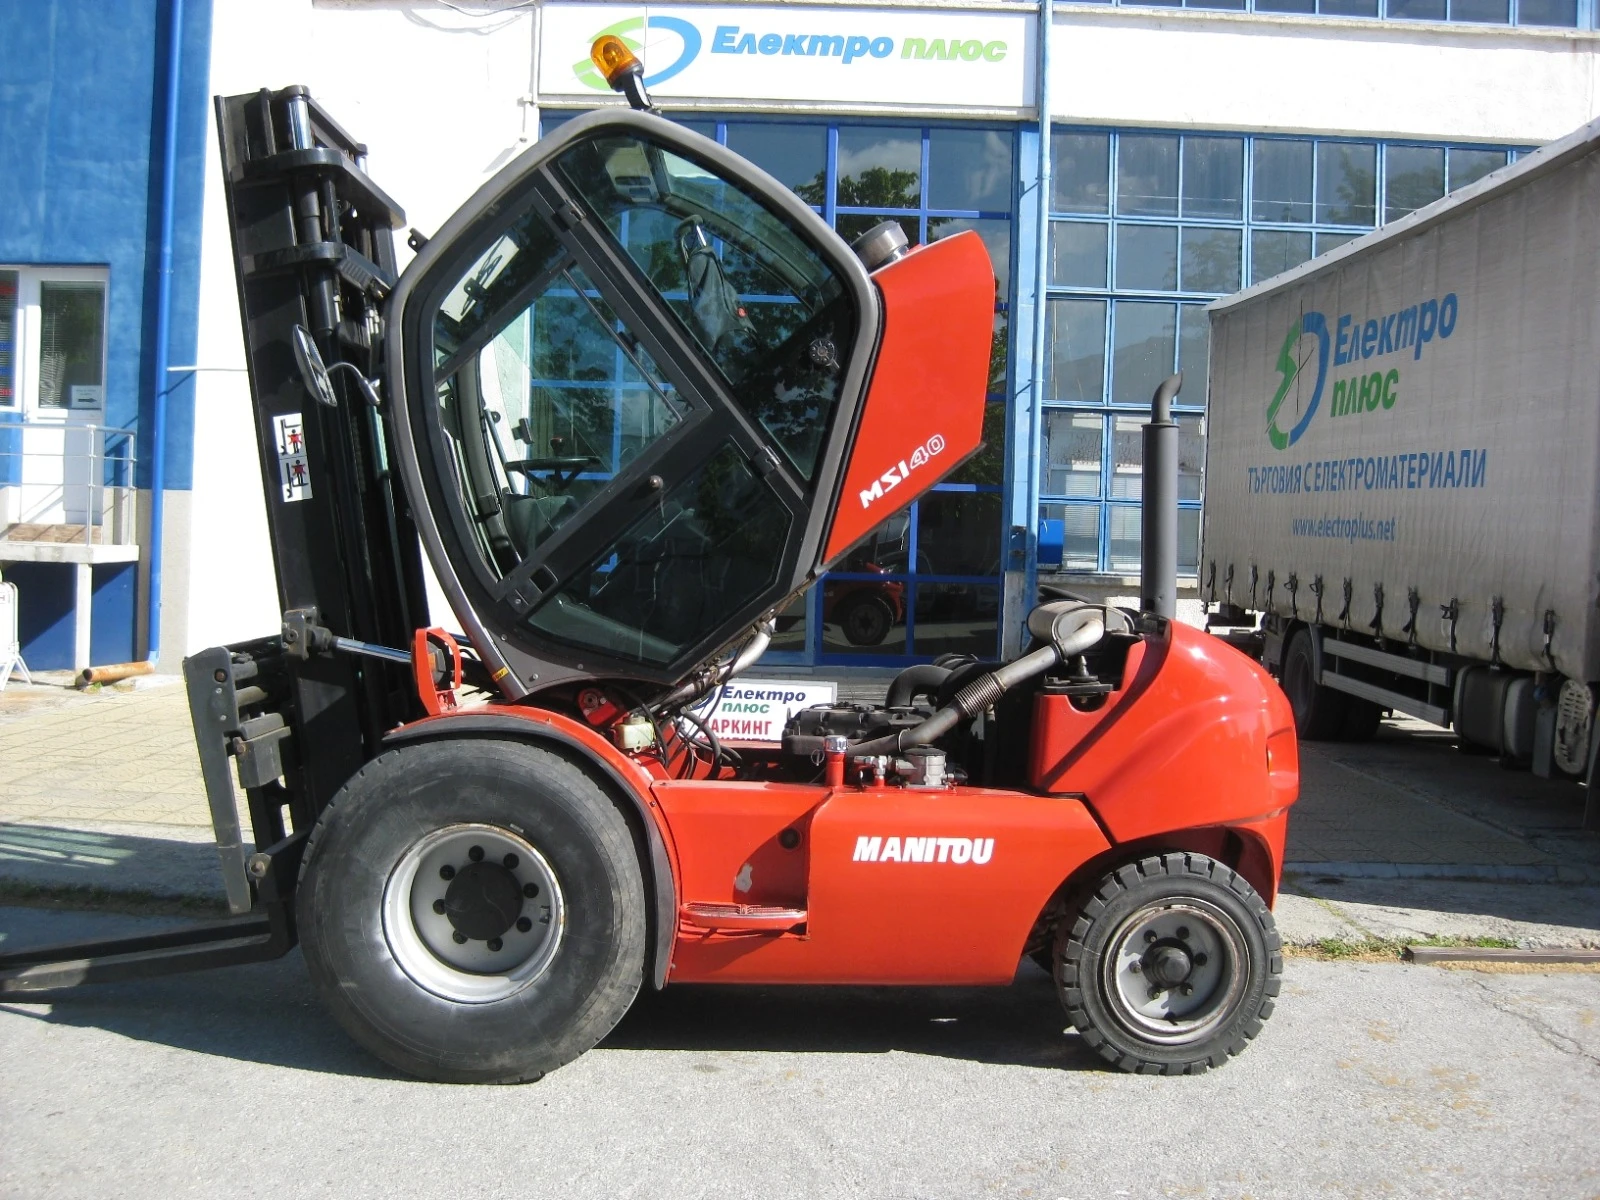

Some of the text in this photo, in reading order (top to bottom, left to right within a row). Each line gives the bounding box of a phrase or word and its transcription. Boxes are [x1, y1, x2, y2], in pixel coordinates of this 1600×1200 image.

[711, 25, 1008, 64] Електро плюс
[1333, 293, 1458, 366] Електро
[1330, 368, 1399, 418] плюс
[1248, 448, 1487, 494] ТЪРГОВИЯ С ЕЛЕКТРОМАТЕРИАЛИ
[1292, 511, 1396, 543] www.electroplus.net
[721, 701, 770, 713] плюс
[722, 685, 806, 704] Електро
[852, 836, 995, 864] MANITOU
